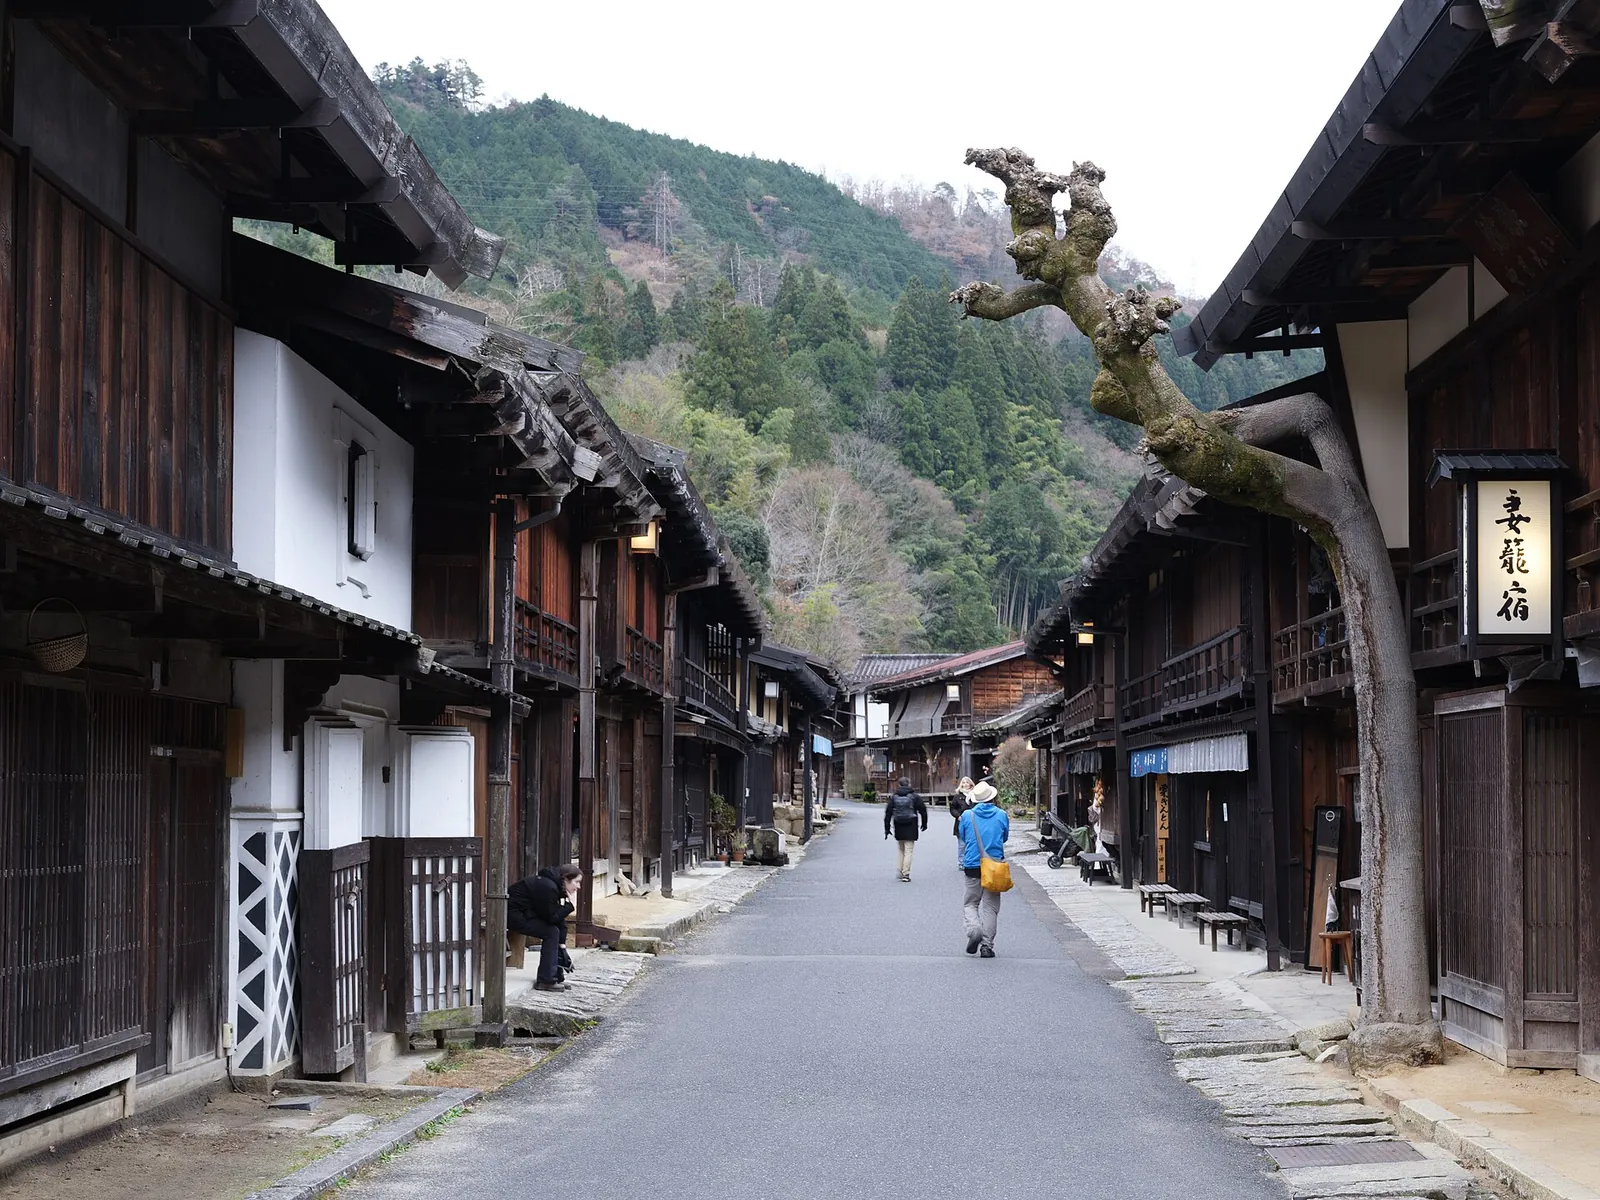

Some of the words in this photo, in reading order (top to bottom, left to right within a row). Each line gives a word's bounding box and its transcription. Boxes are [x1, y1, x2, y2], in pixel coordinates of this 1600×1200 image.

[1495, 488, 1531, 622] 妻籠宿
[1159, 783, 1169, 830] 栗きんとん
